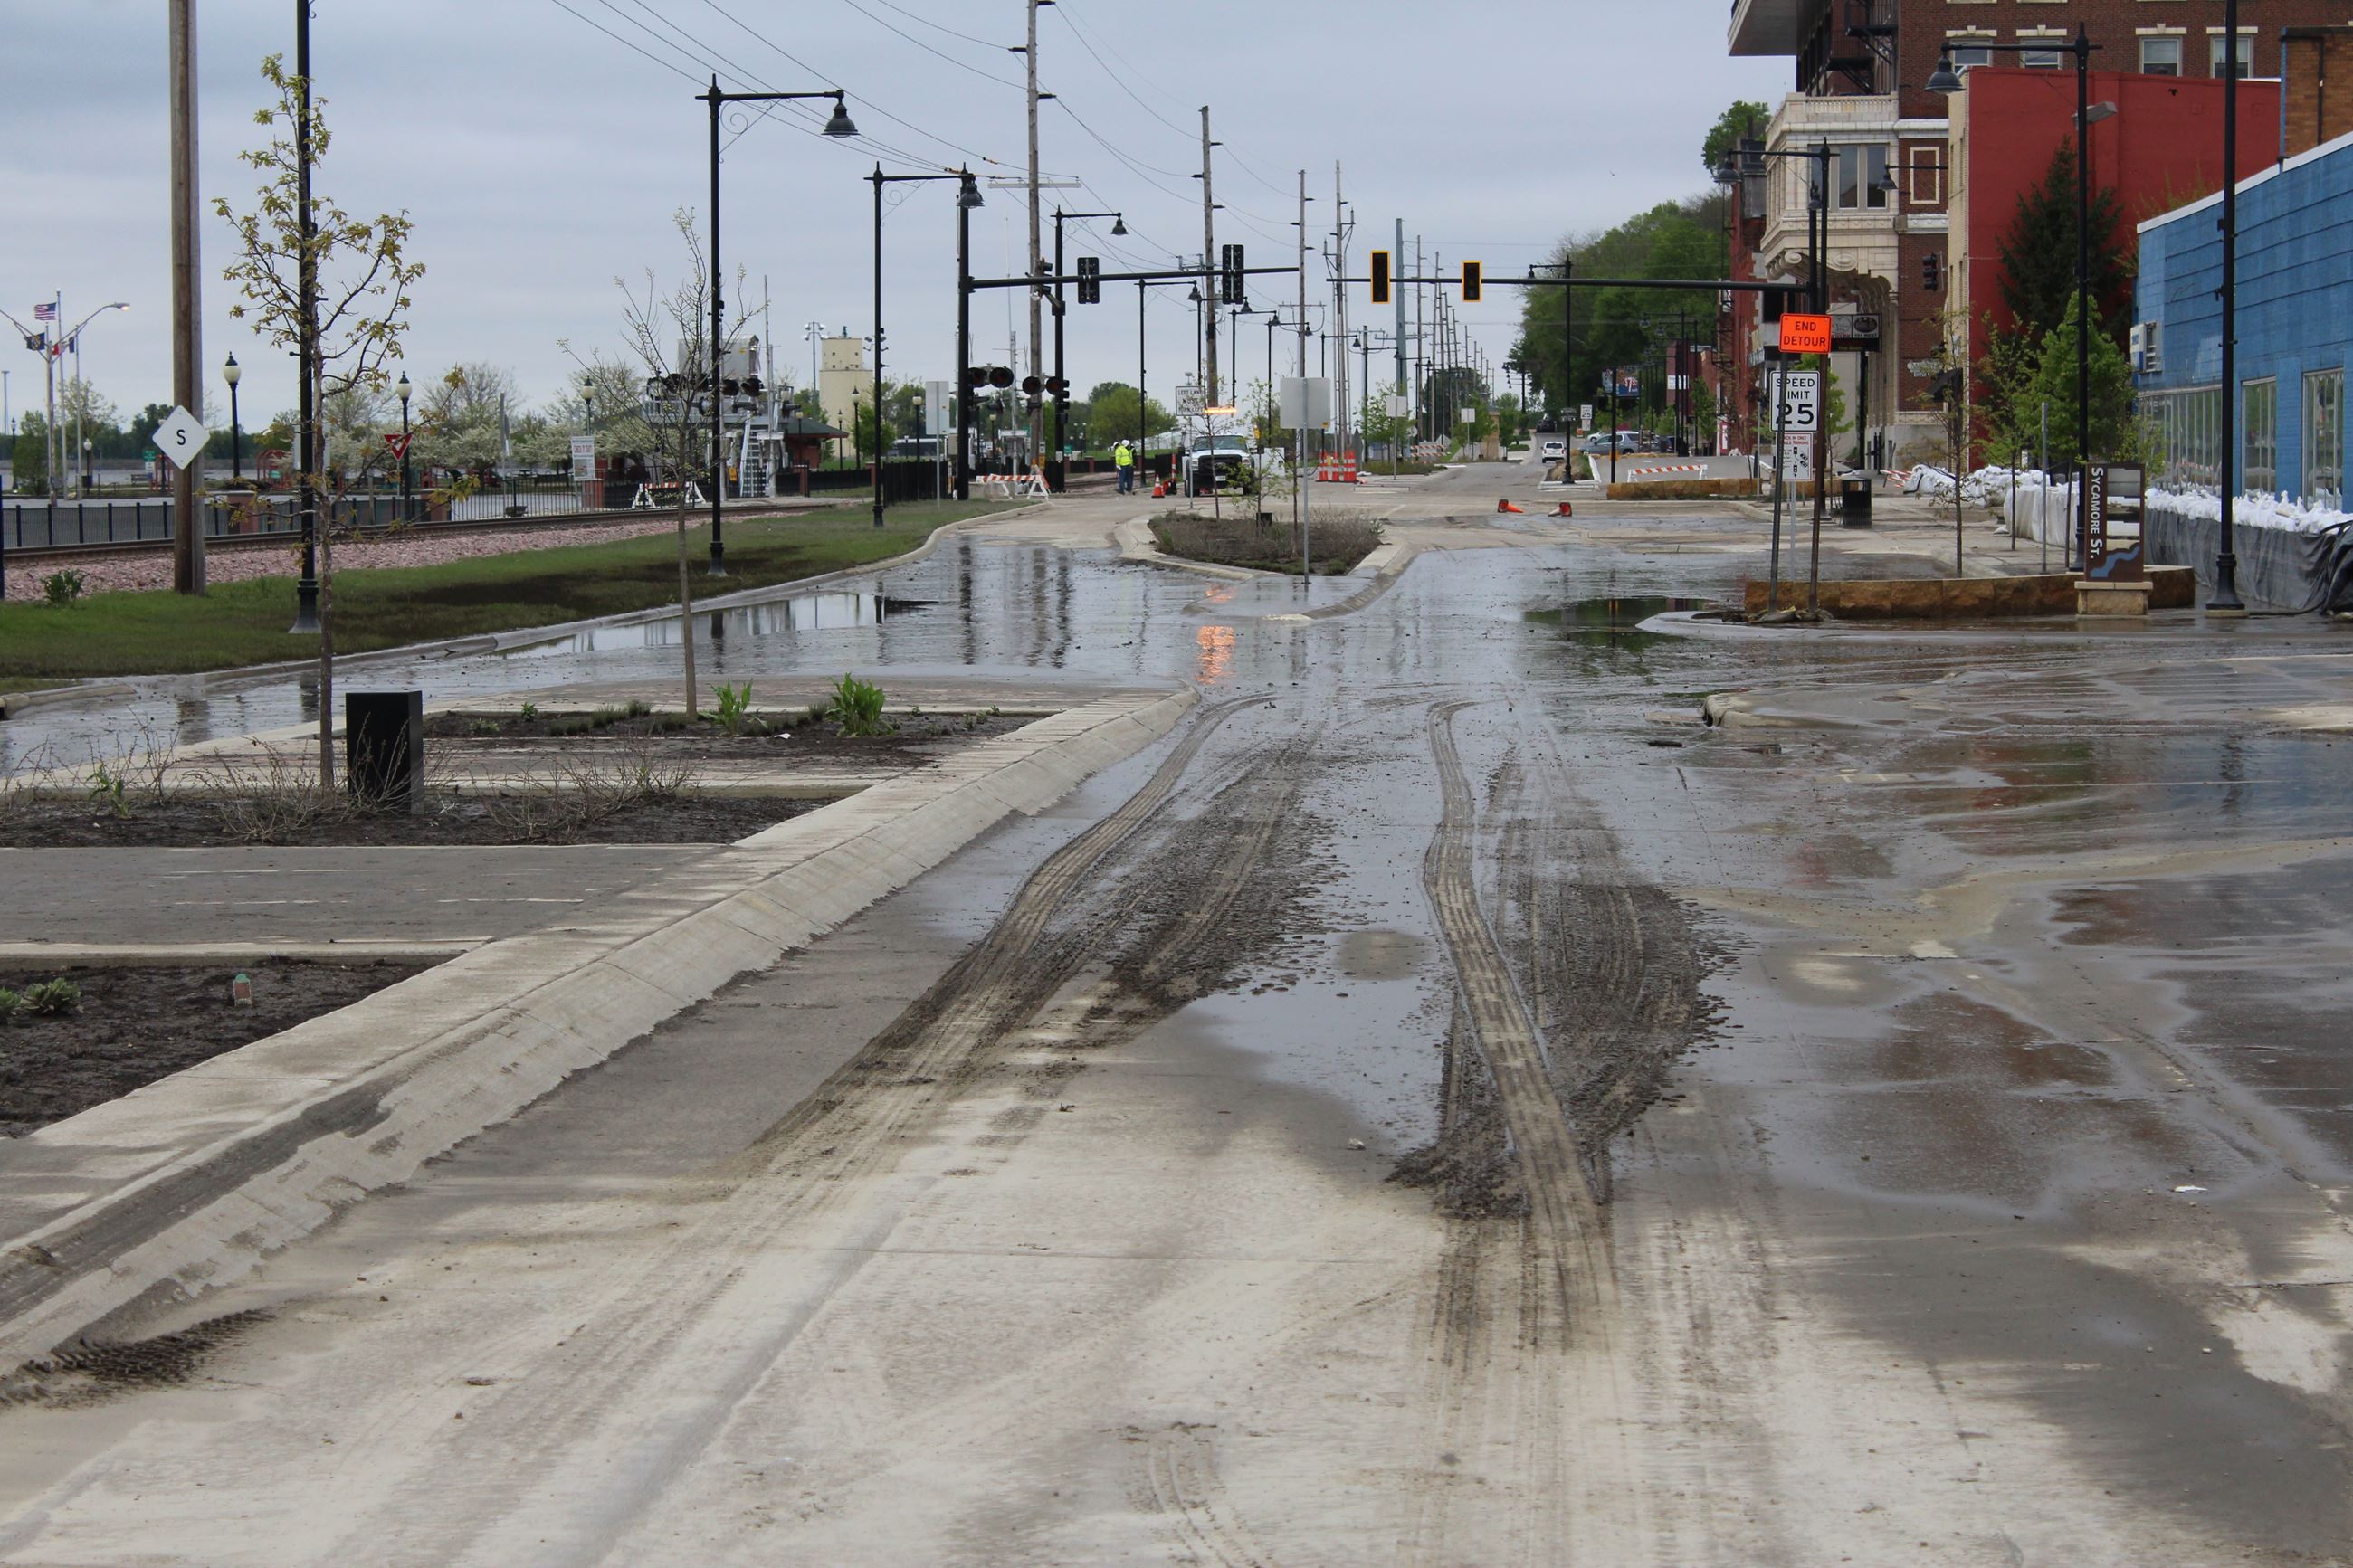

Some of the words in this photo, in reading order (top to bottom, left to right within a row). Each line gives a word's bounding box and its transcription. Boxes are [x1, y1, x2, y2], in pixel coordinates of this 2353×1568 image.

[1795, 321, 1816, 332] END
[1783, 336, 1826, 347] DETOUR
[1776, 378, 1815, 387] SPEED
[1785, 391, 1810, 399] IMIT
[1776, 404, 1814, 424] 25
[176, 429, 186, 445] S
[2091, 467, 2103, 535] SYCAMORE
[2090, 539, 2103, 559] ST.
